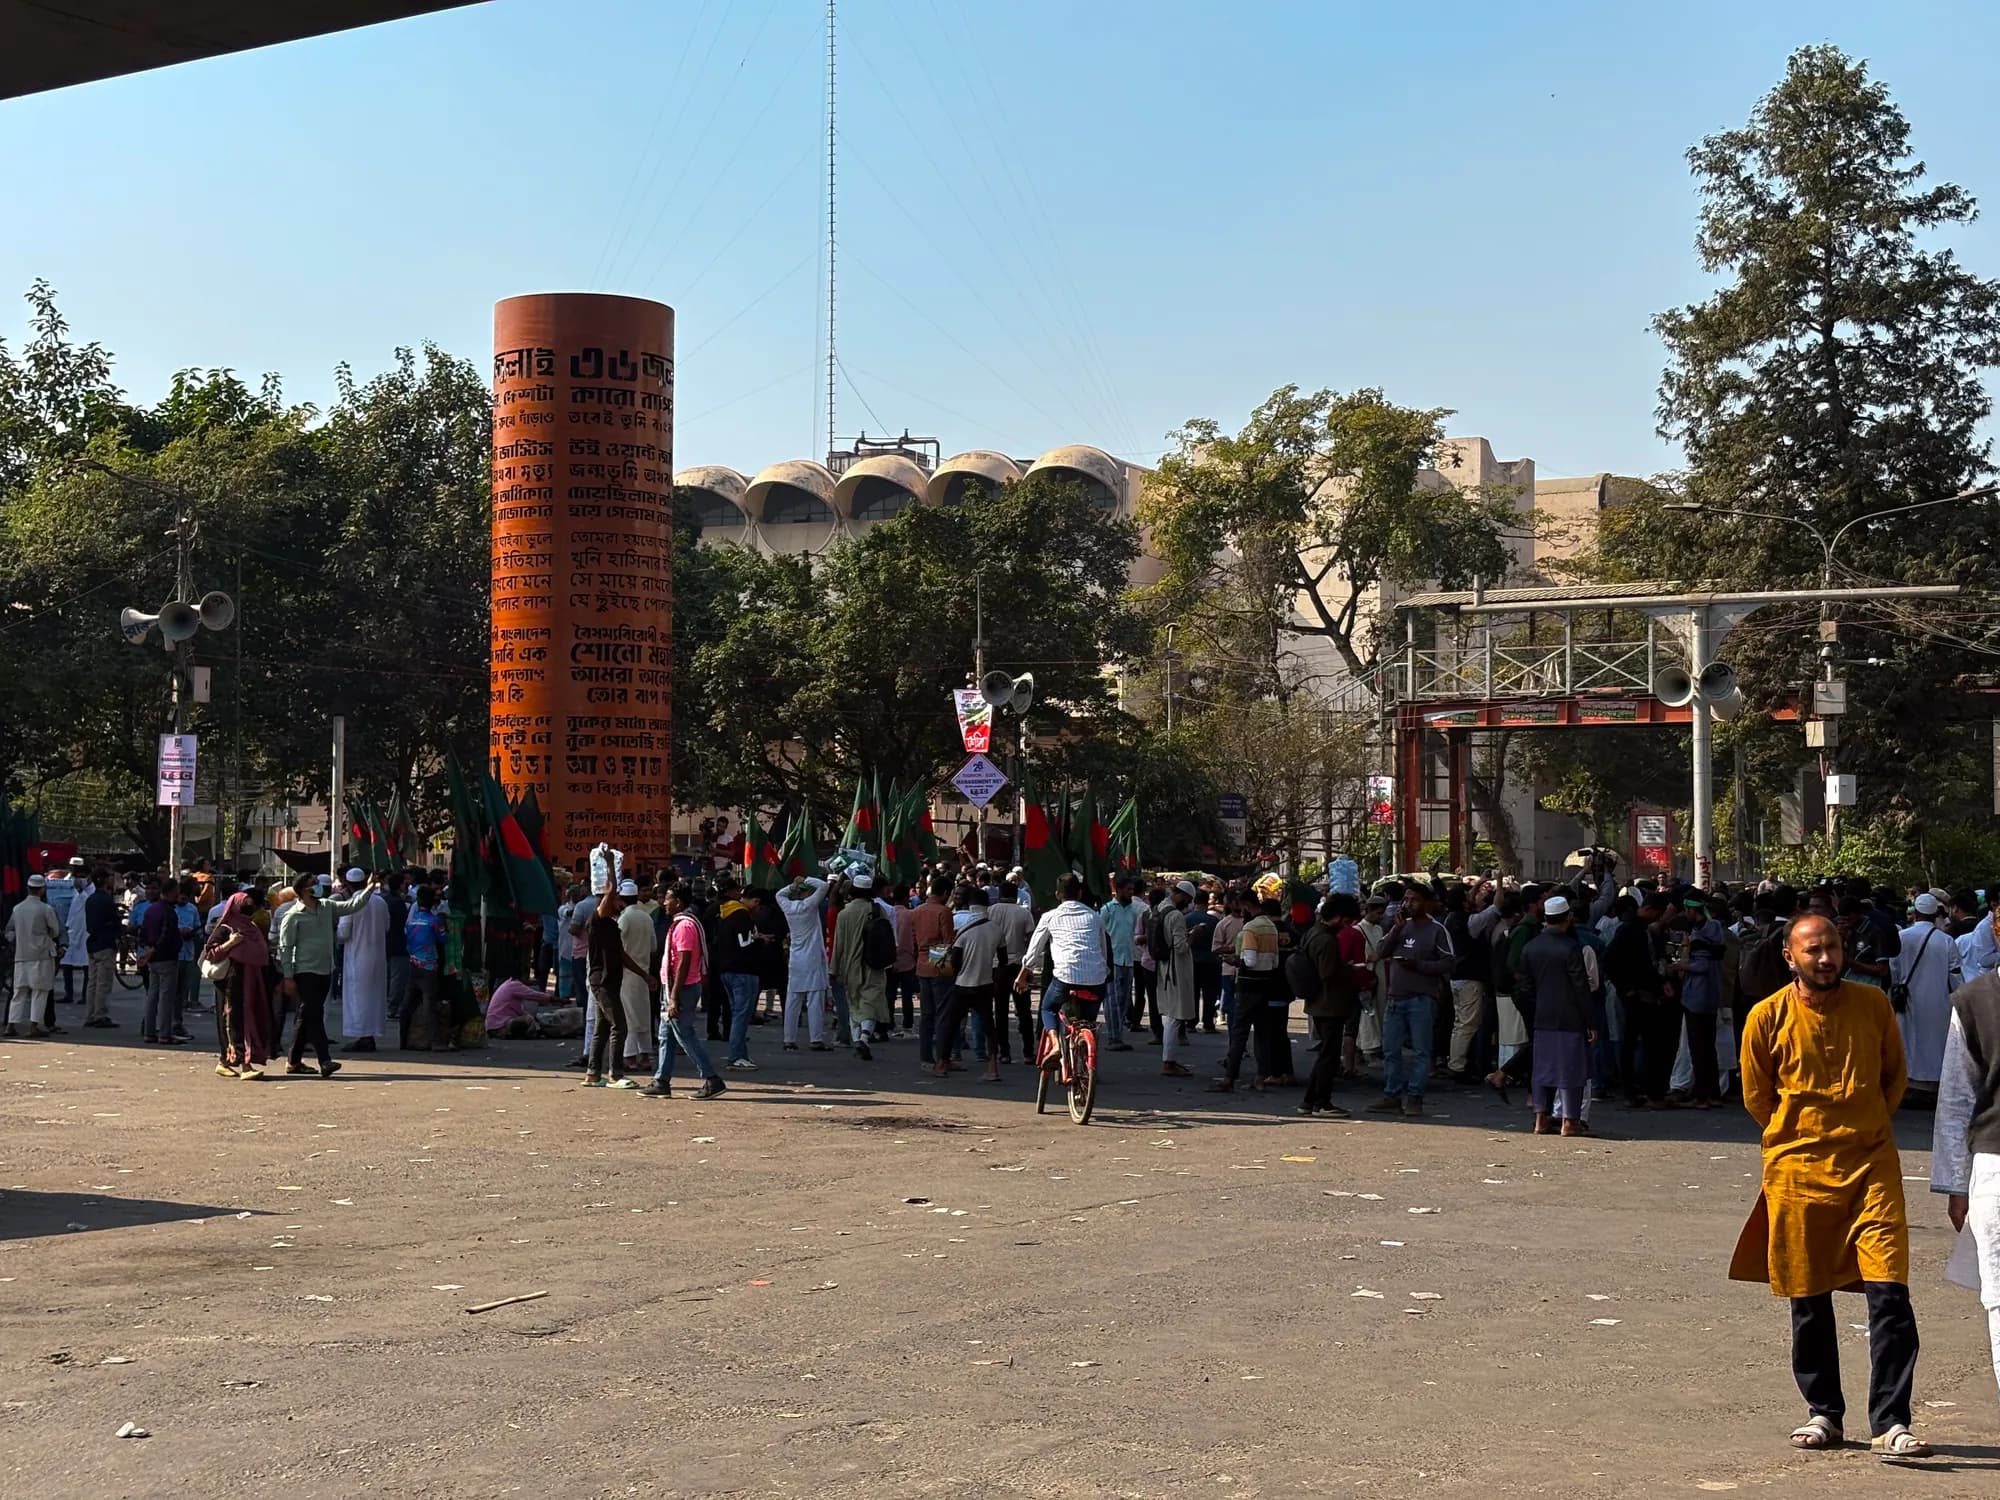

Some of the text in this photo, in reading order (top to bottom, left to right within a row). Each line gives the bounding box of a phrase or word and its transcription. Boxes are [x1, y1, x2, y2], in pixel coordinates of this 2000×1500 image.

[620, 411, 647, 430] তুমি
[503, 550, 553, 569] ইতিহাস
[570, 547, 602, 570] খুনি
[606, 549, 661, 571] হাসিনার
[520, 575, 553, 590] মনে
[522, 595, 553, 609] লাশ
[501, 627, 552, 641] বাংলাদেশ
[519, 646, 549, 662] এক
[570, 642, 642, 665] শোনো
[570, 666, 634, 685] আমরা
[508, 683, 525, 703] কি
[587, 687, 629, 704] তোর
[634, 689, 658, 704] বাপ
[164, 771, 190, 779] TSC
[567, 782, 594, 793] কত
